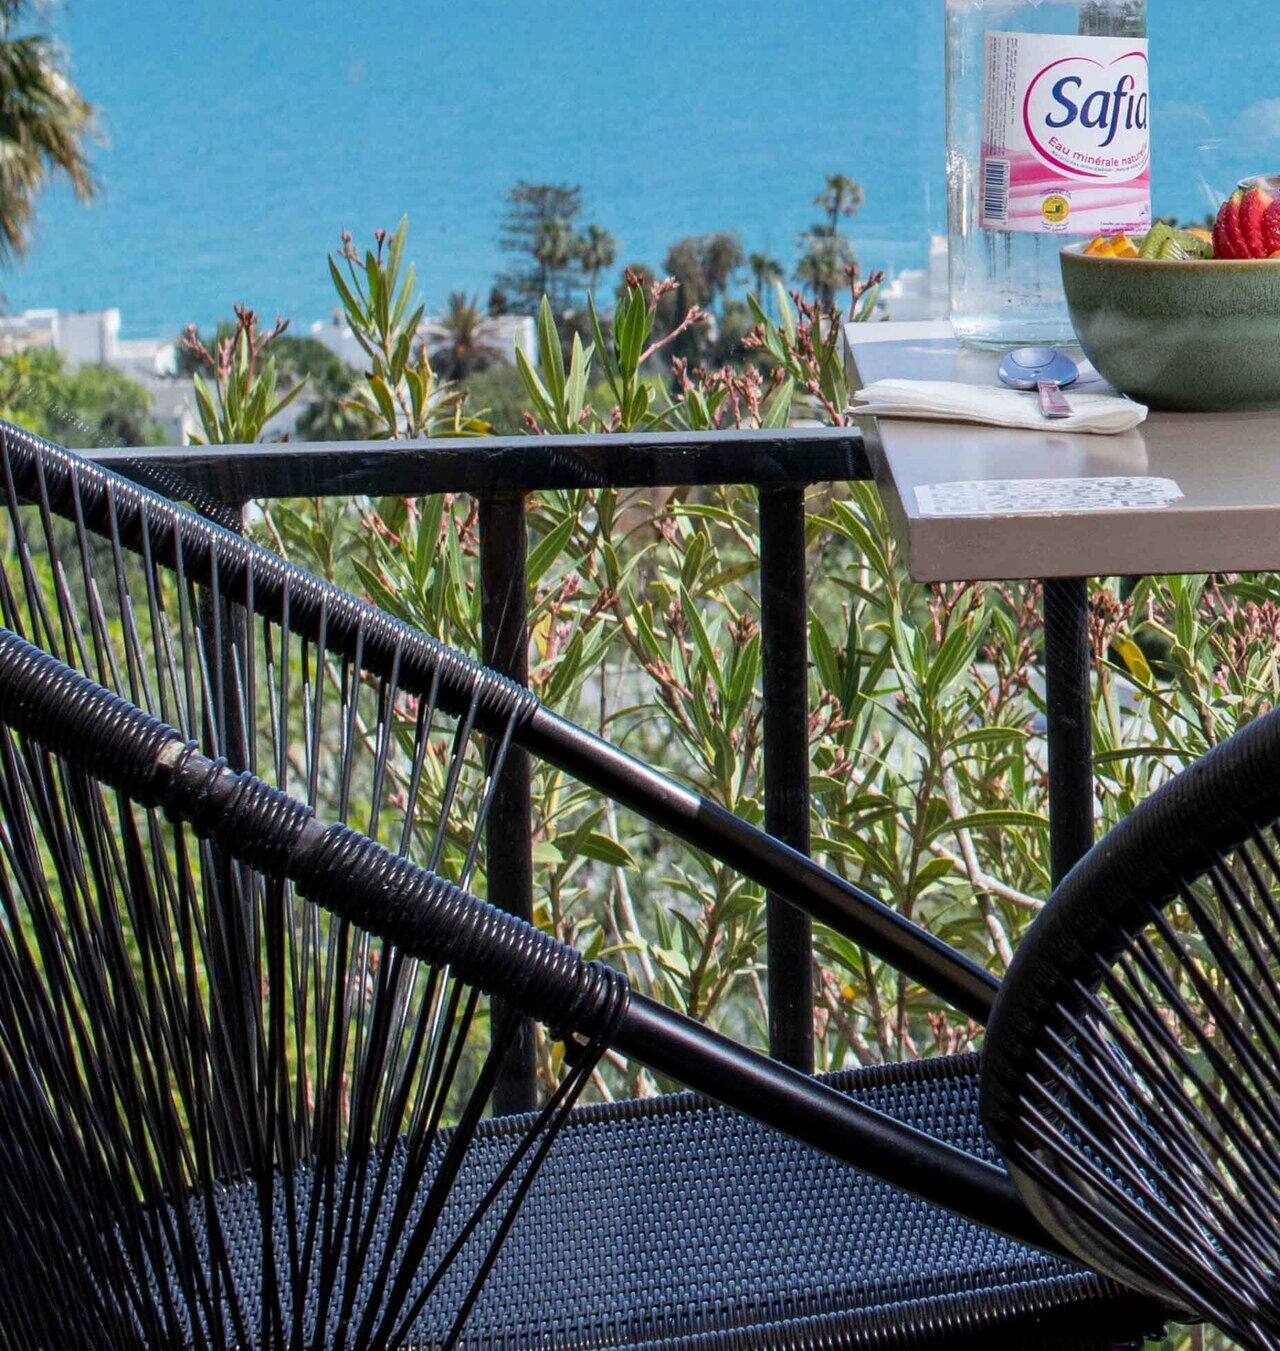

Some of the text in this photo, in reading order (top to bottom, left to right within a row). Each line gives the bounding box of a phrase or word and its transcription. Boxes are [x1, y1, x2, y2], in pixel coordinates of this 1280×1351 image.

[1045, 75, 1147, 147] Safia
[1048, 136, 1070, 155] Eau
[1073, 151, 1119, 167] minérale
